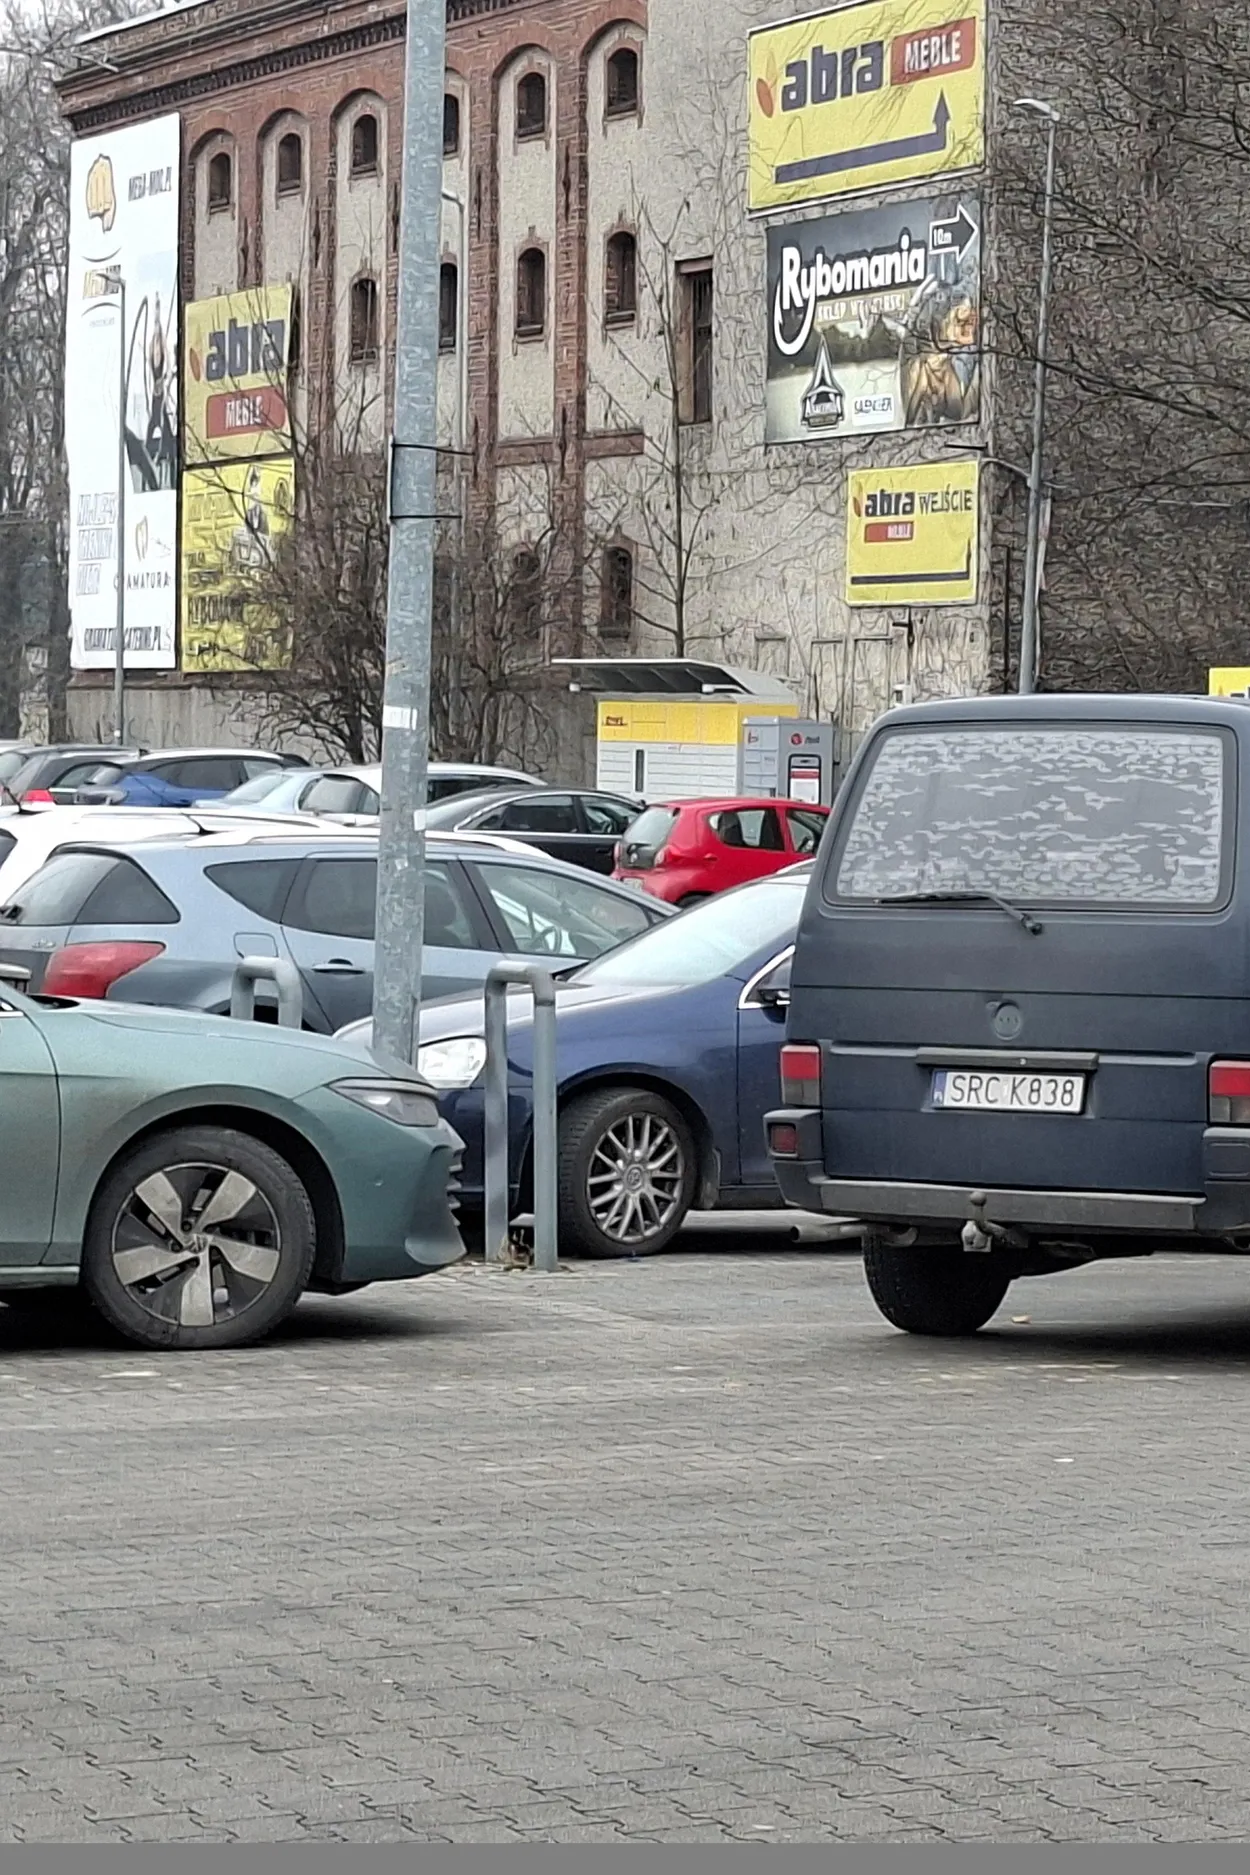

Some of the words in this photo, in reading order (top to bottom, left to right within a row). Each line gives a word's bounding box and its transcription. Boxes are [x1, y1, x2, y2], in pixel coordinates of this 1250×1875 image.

[781, 40, 884, 112] abra
[904, 30, 962, 74] MEBLE
[774, 234, 926, 356] Rybomania
[206, 318, 285, 381] abra
[225, 396, 264, 428] MEBLE
[951, 1074, 1001, 1104] SRC
[1010, 1076, 1075, 1107] K838
